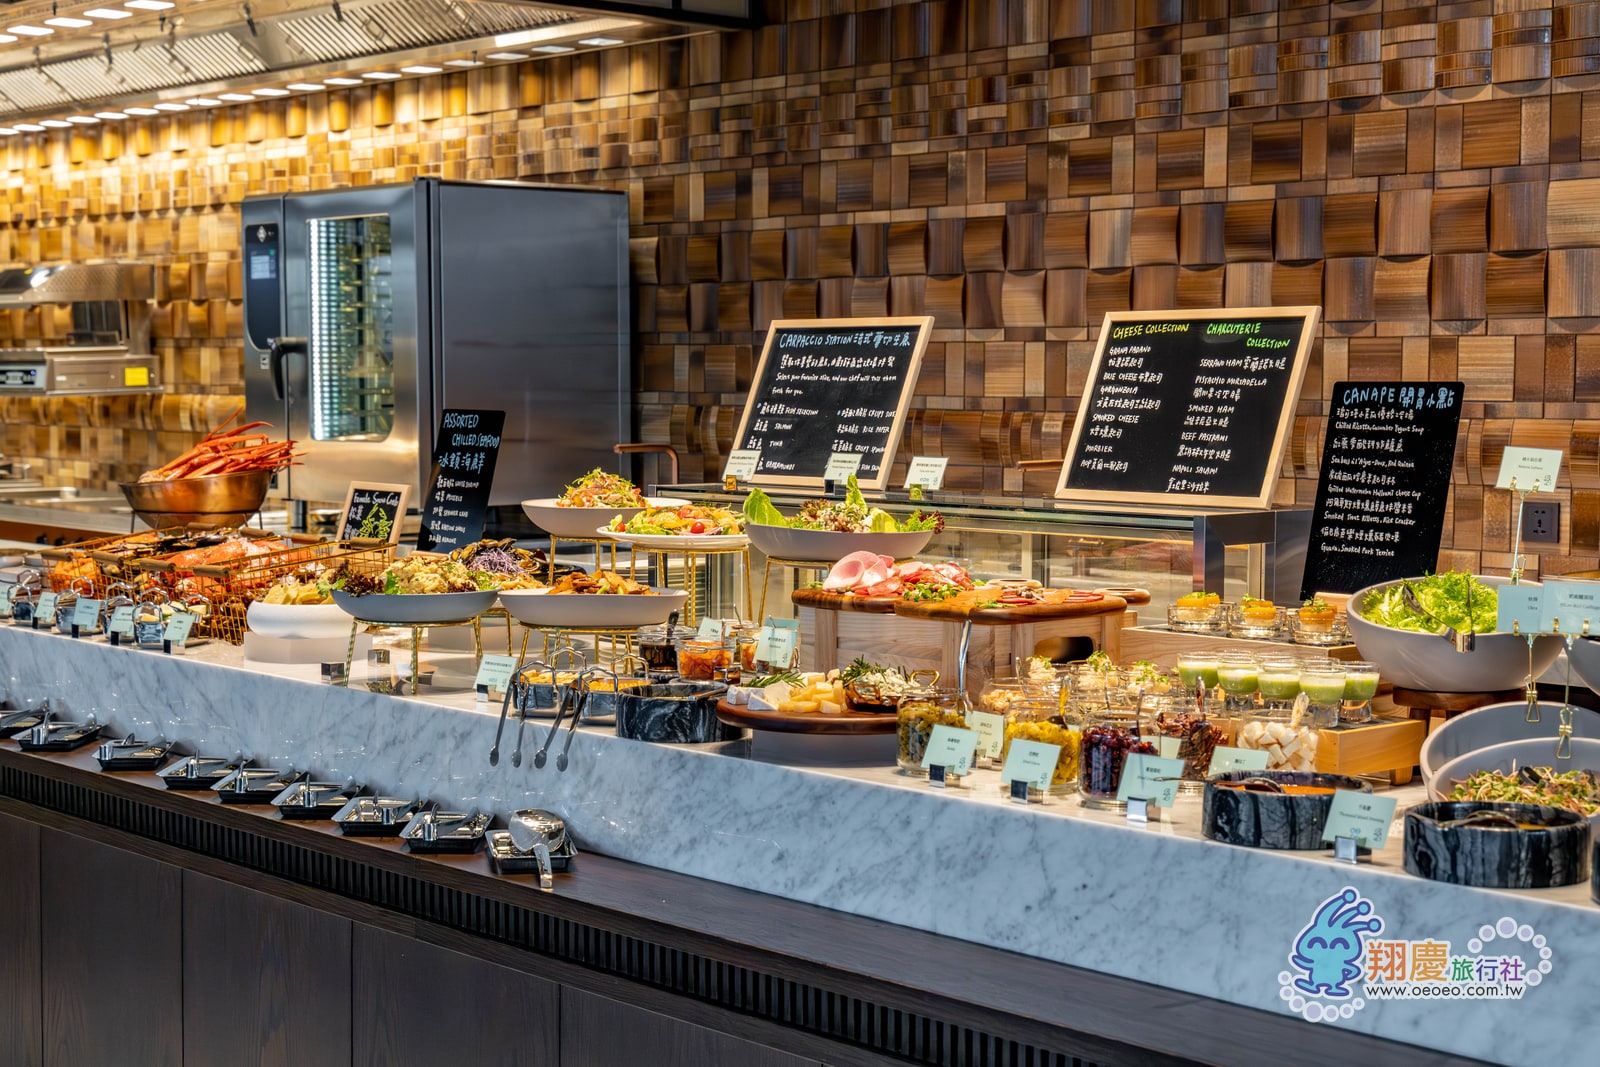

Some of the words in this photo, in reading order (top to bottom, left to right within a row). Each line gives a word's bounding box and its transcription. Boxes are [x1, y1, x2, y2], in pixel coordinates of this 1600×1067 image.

[1113, 325, 1143, 339] CHEESE
[1145, 323, 1190, 334] COLLECTION
[1206, 323, 1261, 335] CHARCUTERIE
[780, 333, 822, 348] CARPACCIO
[825, 334, 853, 345] STATION
[1246, 337, 1291, 349] COLLECTION
[1200, 358, 1225, 367] SERRANO
[1225, 358, 1243, 367] HAM
[1118, 372, 1138, 381] CHEESE
[1343, 386, 1396, 405] CANAPE
[1187, 404, 1214, 413] SMOKED
[1217, 405, 1235, 413] HAM
[443, 413, 479, 428] ASSORTED
[1118, 414, 1140, 423] CHEESE
[452, 433, 477, 447] CHILLED
[1181, 431, 1197, 441] BEEF
[1198, 432, 1229, 442] PASTRAMI
[1172, 464, 1193, 473] NAPOLI
